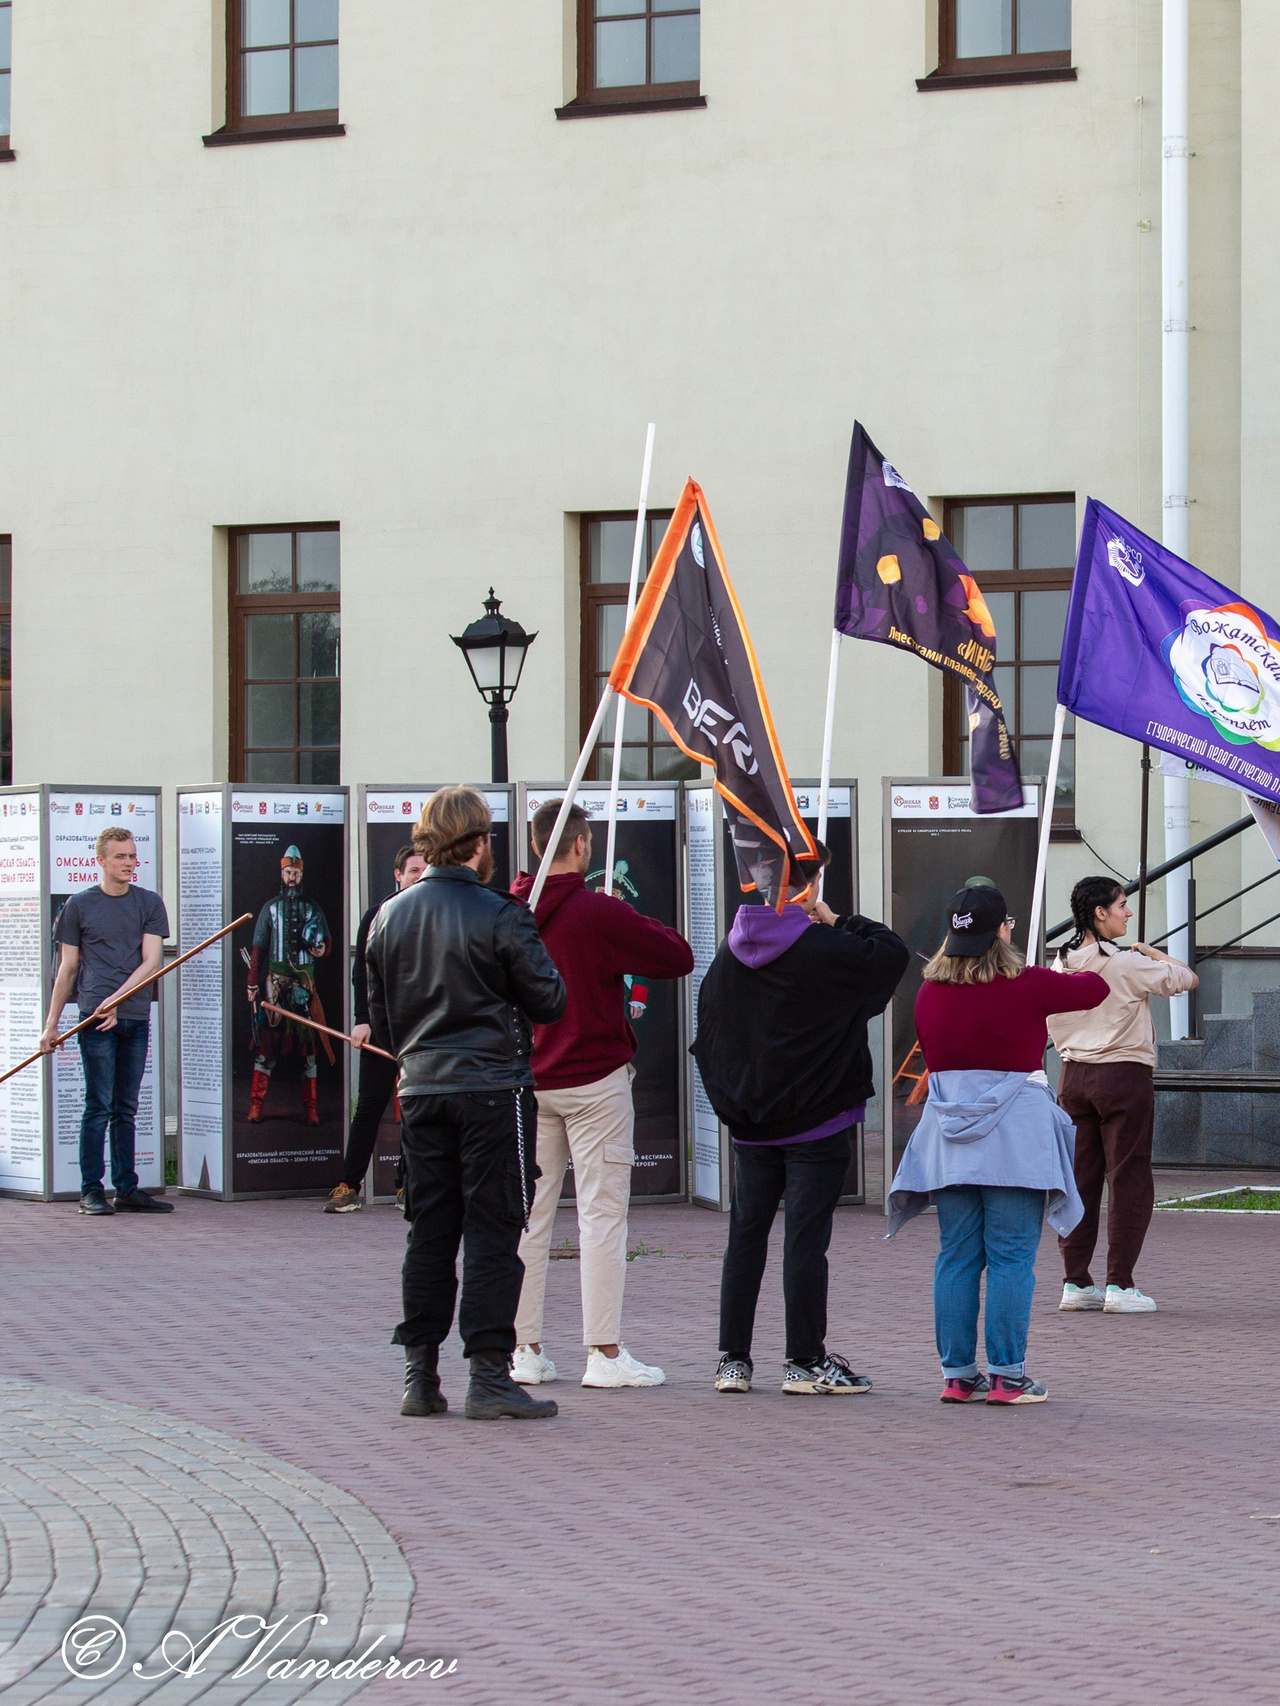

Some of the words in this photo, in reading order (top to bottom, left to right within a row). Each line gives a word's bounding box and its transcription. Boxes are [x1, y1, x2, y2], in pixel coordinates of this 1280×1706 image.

[1146, 720, 1208, 756] СТУДЕНЧЕСКИЙ
[1206, 744, 1273, 789] ПЕДАГОГИЧЕСКИЙ
[56, 857, 96, 867] ОМСКАЯ
[68, 872, 98, 882] ЗЕМЛЯ
